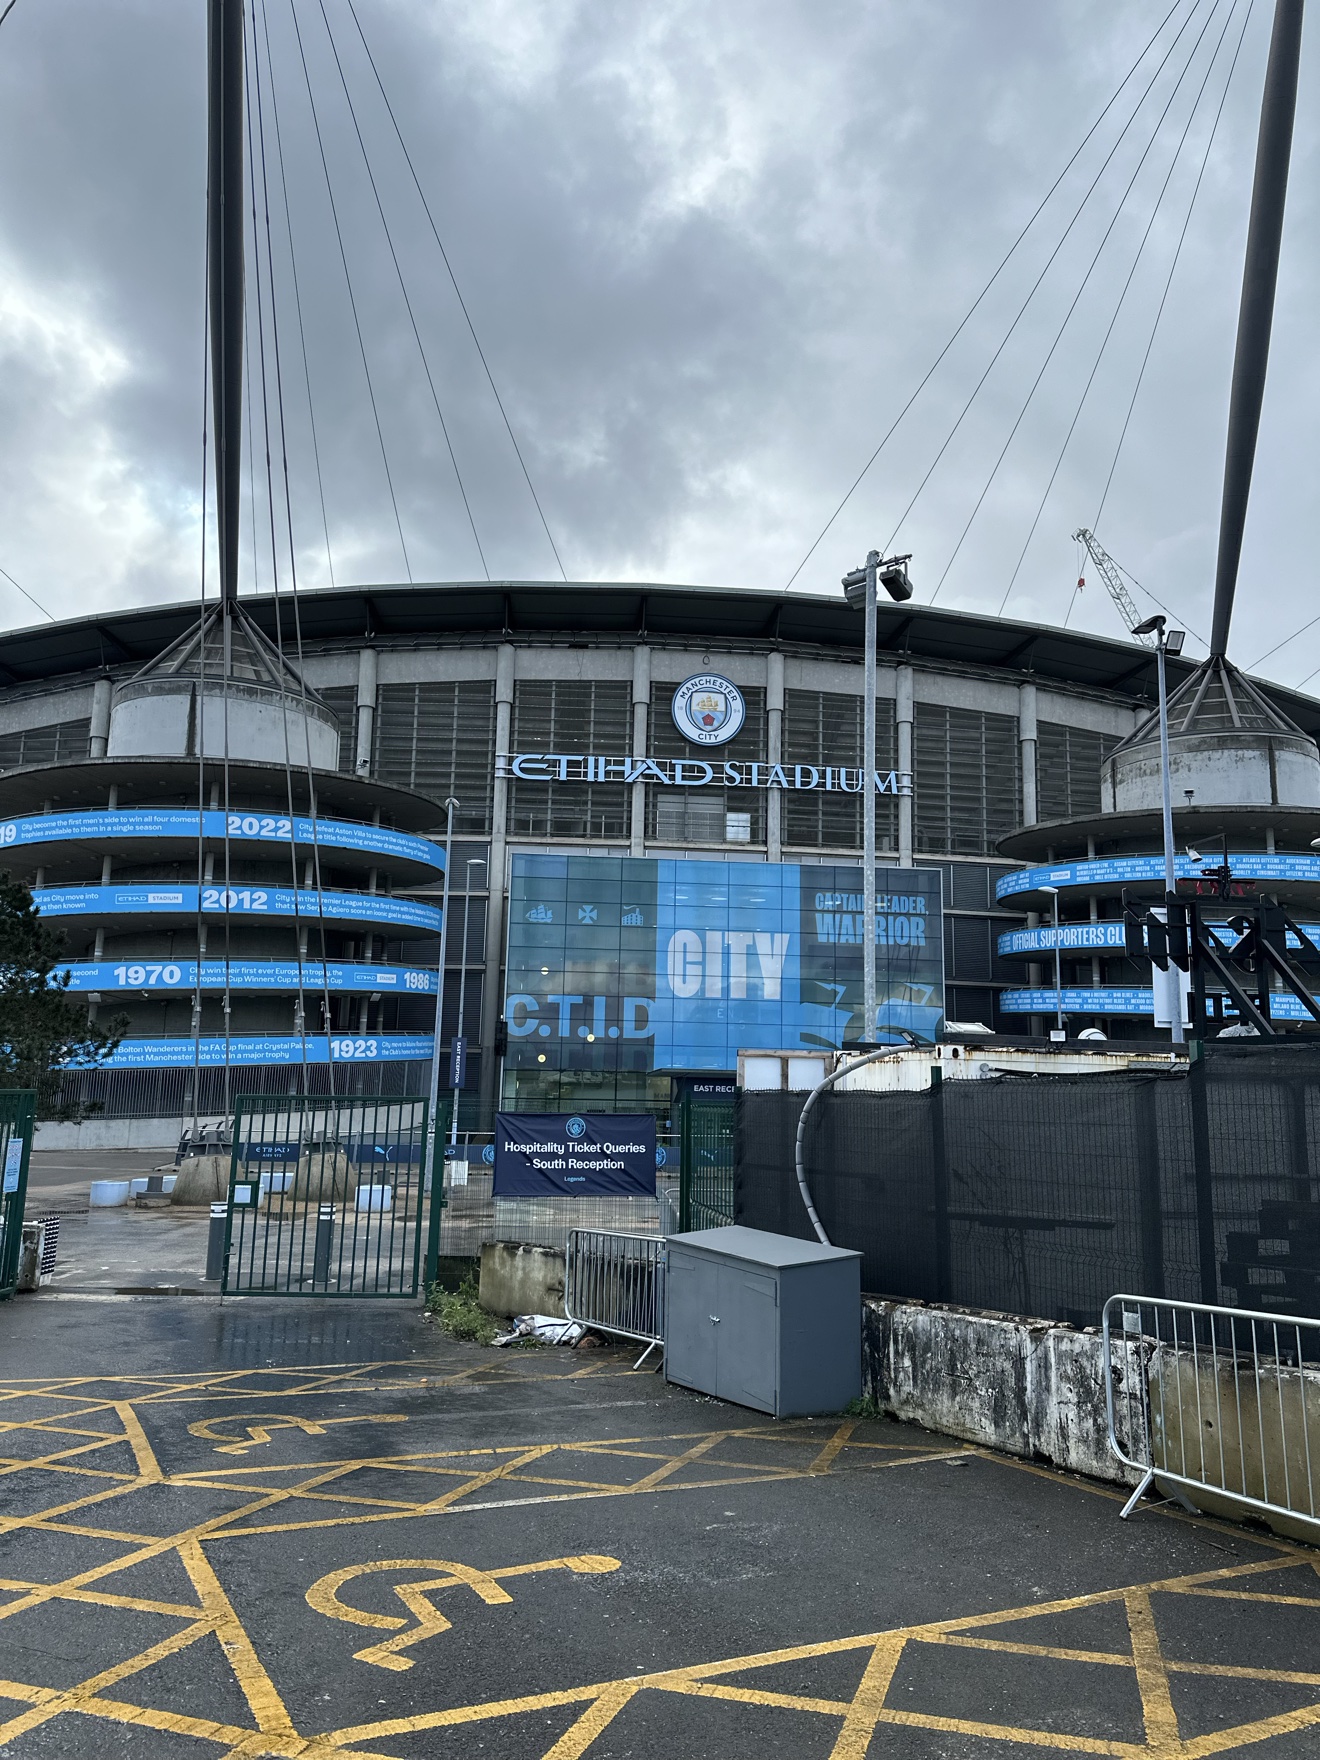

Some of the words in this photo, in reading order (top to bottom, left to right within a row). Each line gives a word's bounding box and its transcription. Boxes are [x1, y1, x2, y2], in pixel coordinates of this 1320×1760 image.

[680, 678, 738, 702] MANCHESTER
[512, 754, 714, 786] ETIHAD
[724, 761, 898, 794] STADIUM
[21, 831, 44, 839] trophies
[44, 828, 72, 836] available
[112, 824, 134, 832] single
[226, 816, 292, 838] 2022
[299, 823, 313, 832] City
[316, 824, 334, 832] defeat
[335, 827, 352, 835] Aston
[353, 830, 366, 838] Villa
[372, 834, 388, 842] secure
[336, 834, 363, 846] following
[364, 840, 384, 848] another
[52, 894, 65, 904] City
[202, 890, 268, 910] 2012
[276, 894, 290, 902] City
[342, 899, 362, 907] League
[876, 894, 929, 916] LEADER,
[328, 906, 350, 914] Agüero
[815, 913, 926, 946] WARRIOR
[1012, 932, 1040, 950] OFFICIAL
[1040, 926, 1105, 948] SUPPORTERS
[190, 966, 206, 975] Ciy
[668, 930, 790, 1000] CITY
[114, 965, 182, 985] 1970
[190, 976, 226, 984] European
[228, 976, 242, 984] Cup
[278, 976, 292, 984] Cup
[404, 972, 430, 990] 1986
[506, 994, 655, 1038] C.T.I.D
[242, 1052, 264, 1060] major
[264, 1043, 290, 1051] Crystal
[330, 1040, 378, 1058] 1923
[504, 1142, 565, 1154] Hospitality
[566, 1142, 601, 1152] Ticket
[603, 1142, 646, 1154] Queries
[532, 1158, 566, 1169] South
[568, 1158, 624, 1171] Reception
